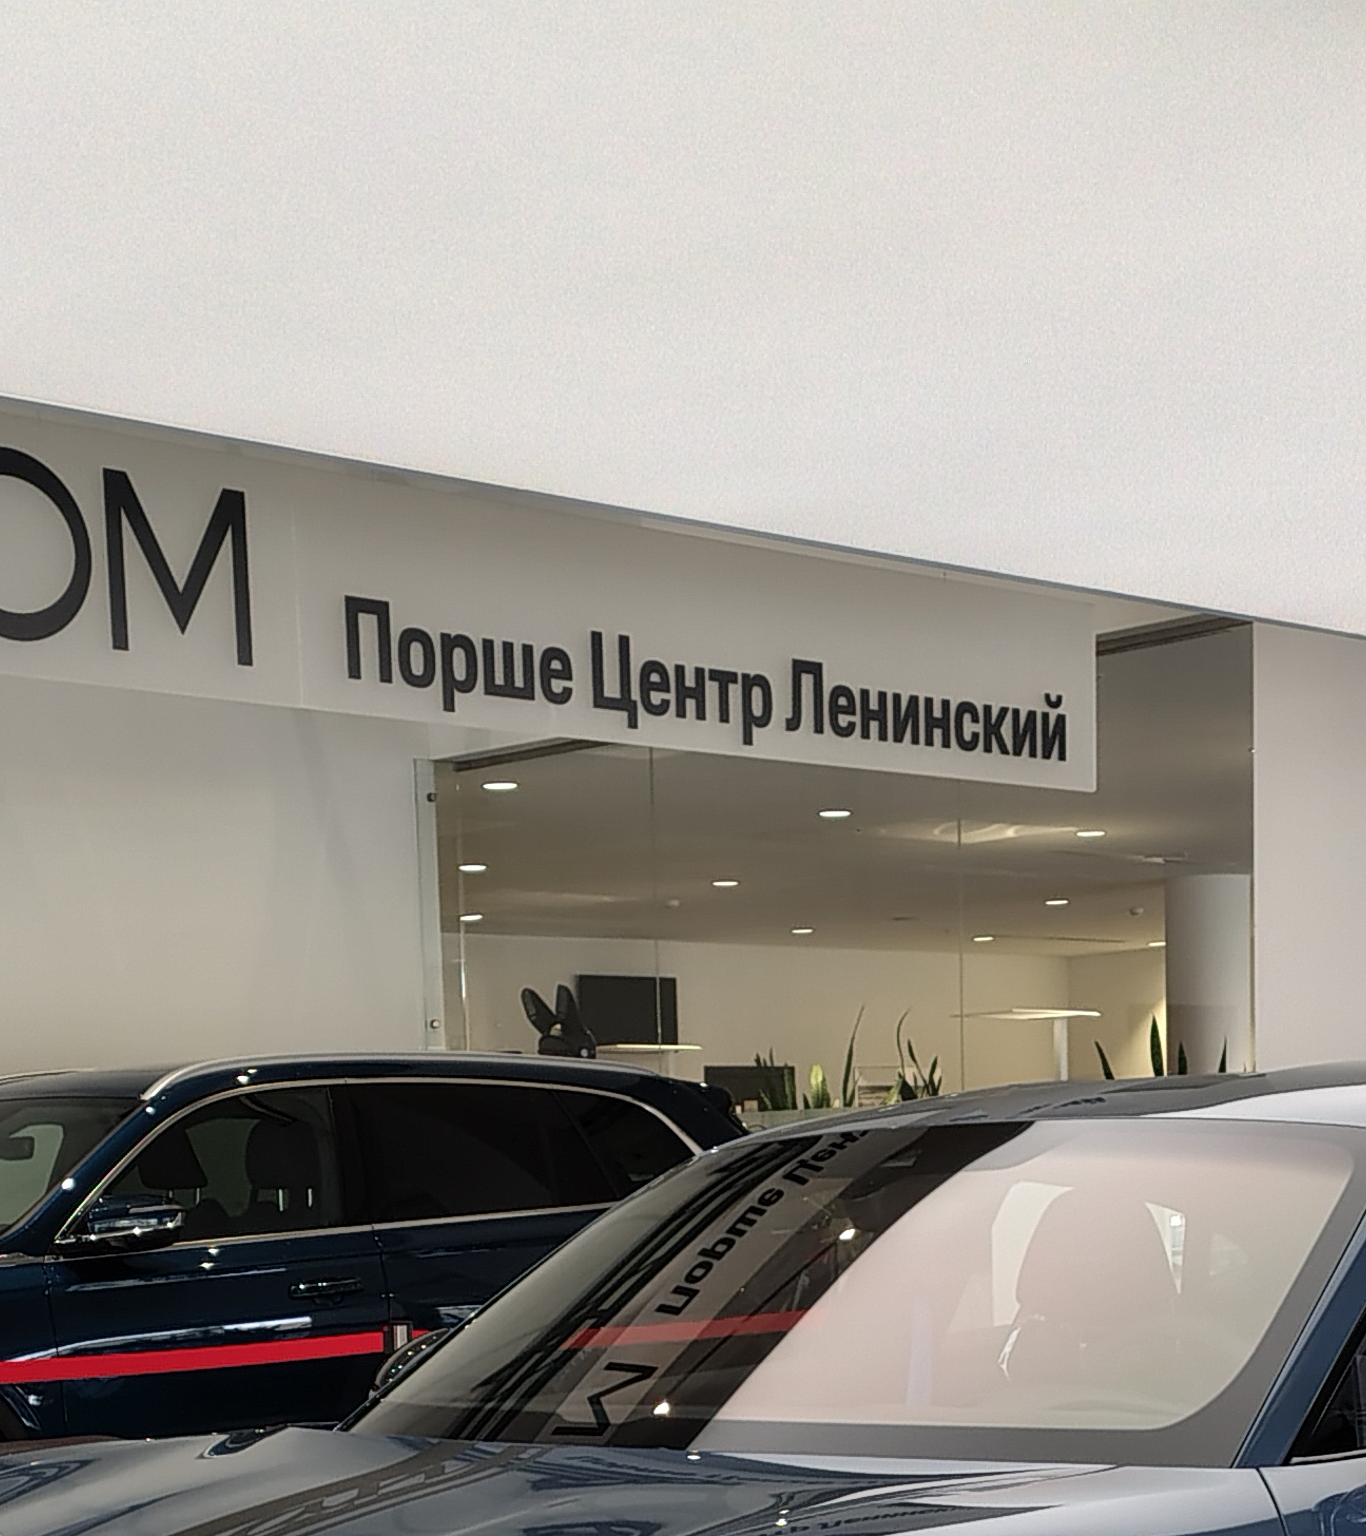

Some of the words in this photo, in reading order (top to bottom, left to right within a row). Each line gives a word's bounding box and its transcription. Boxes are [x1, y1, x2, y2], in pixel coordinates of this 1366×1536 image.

[345, 595, 573, 712] Порше
[591, 631, 773, 746] Центр
[785, 659, 1067, 761] Ленинский
